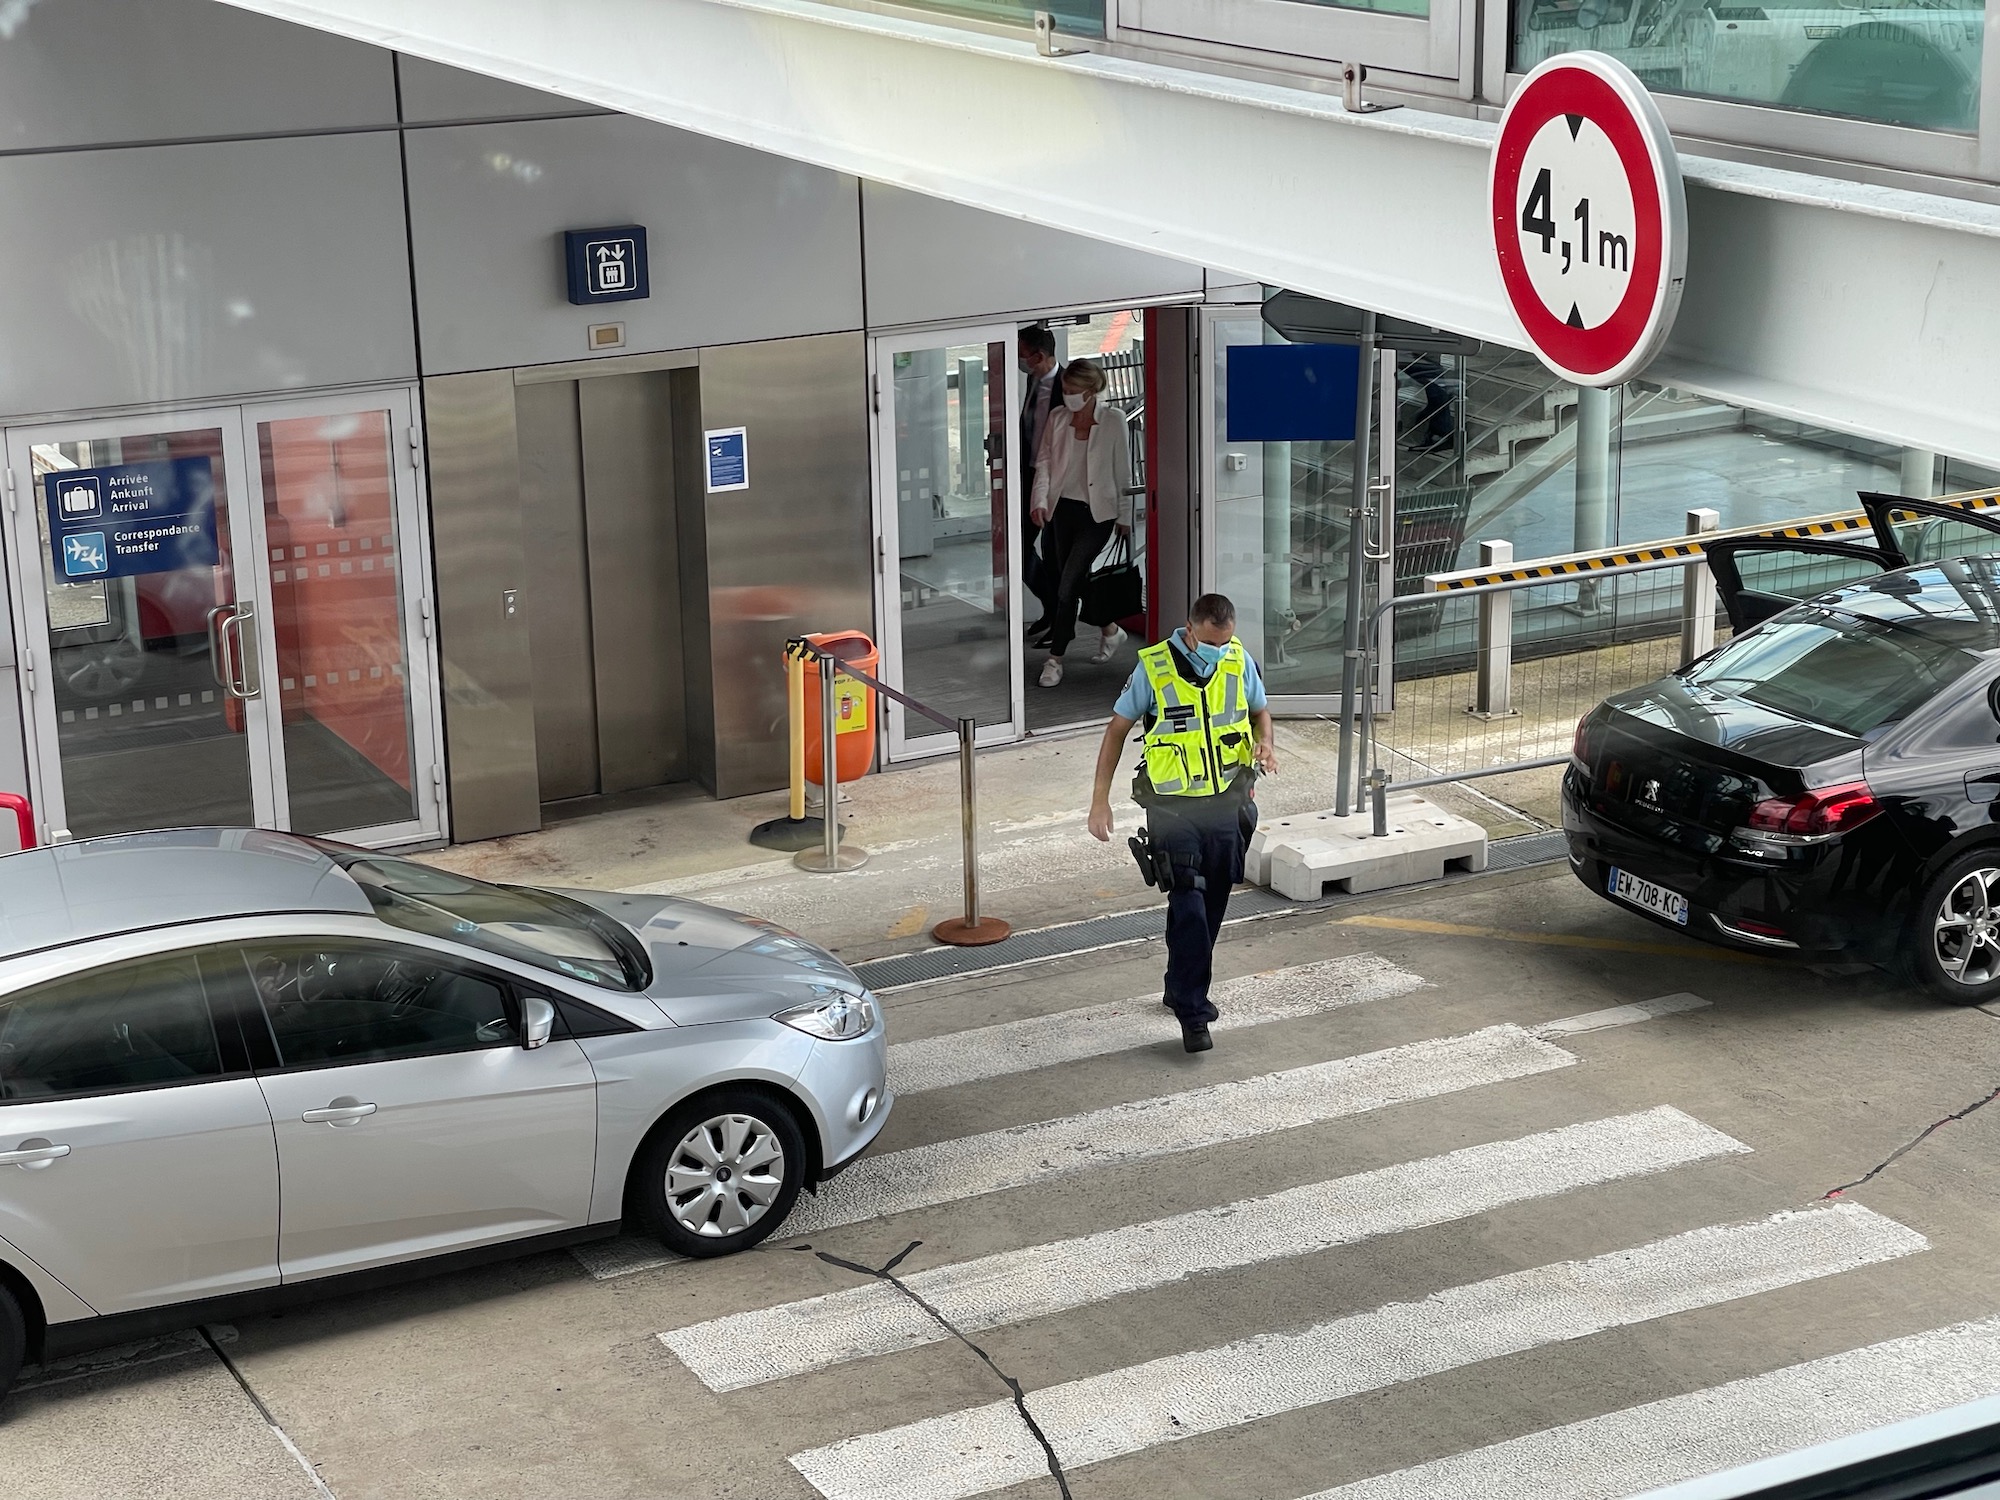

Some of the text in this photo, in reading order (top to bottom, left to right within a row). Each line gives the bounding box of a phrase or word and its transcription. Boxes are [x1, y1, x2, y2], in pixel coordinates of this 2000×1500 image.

[109, 474, 149, 487] Arrivée
[110, 486, 153, 499] Ankunft
[112, 500, 149, 513] Arrival
[114, 525, 200, 540] Correspondance
[116, 541, 160, 555] Transfer
[1617, 872, 1680, 915] EW-708-KC
